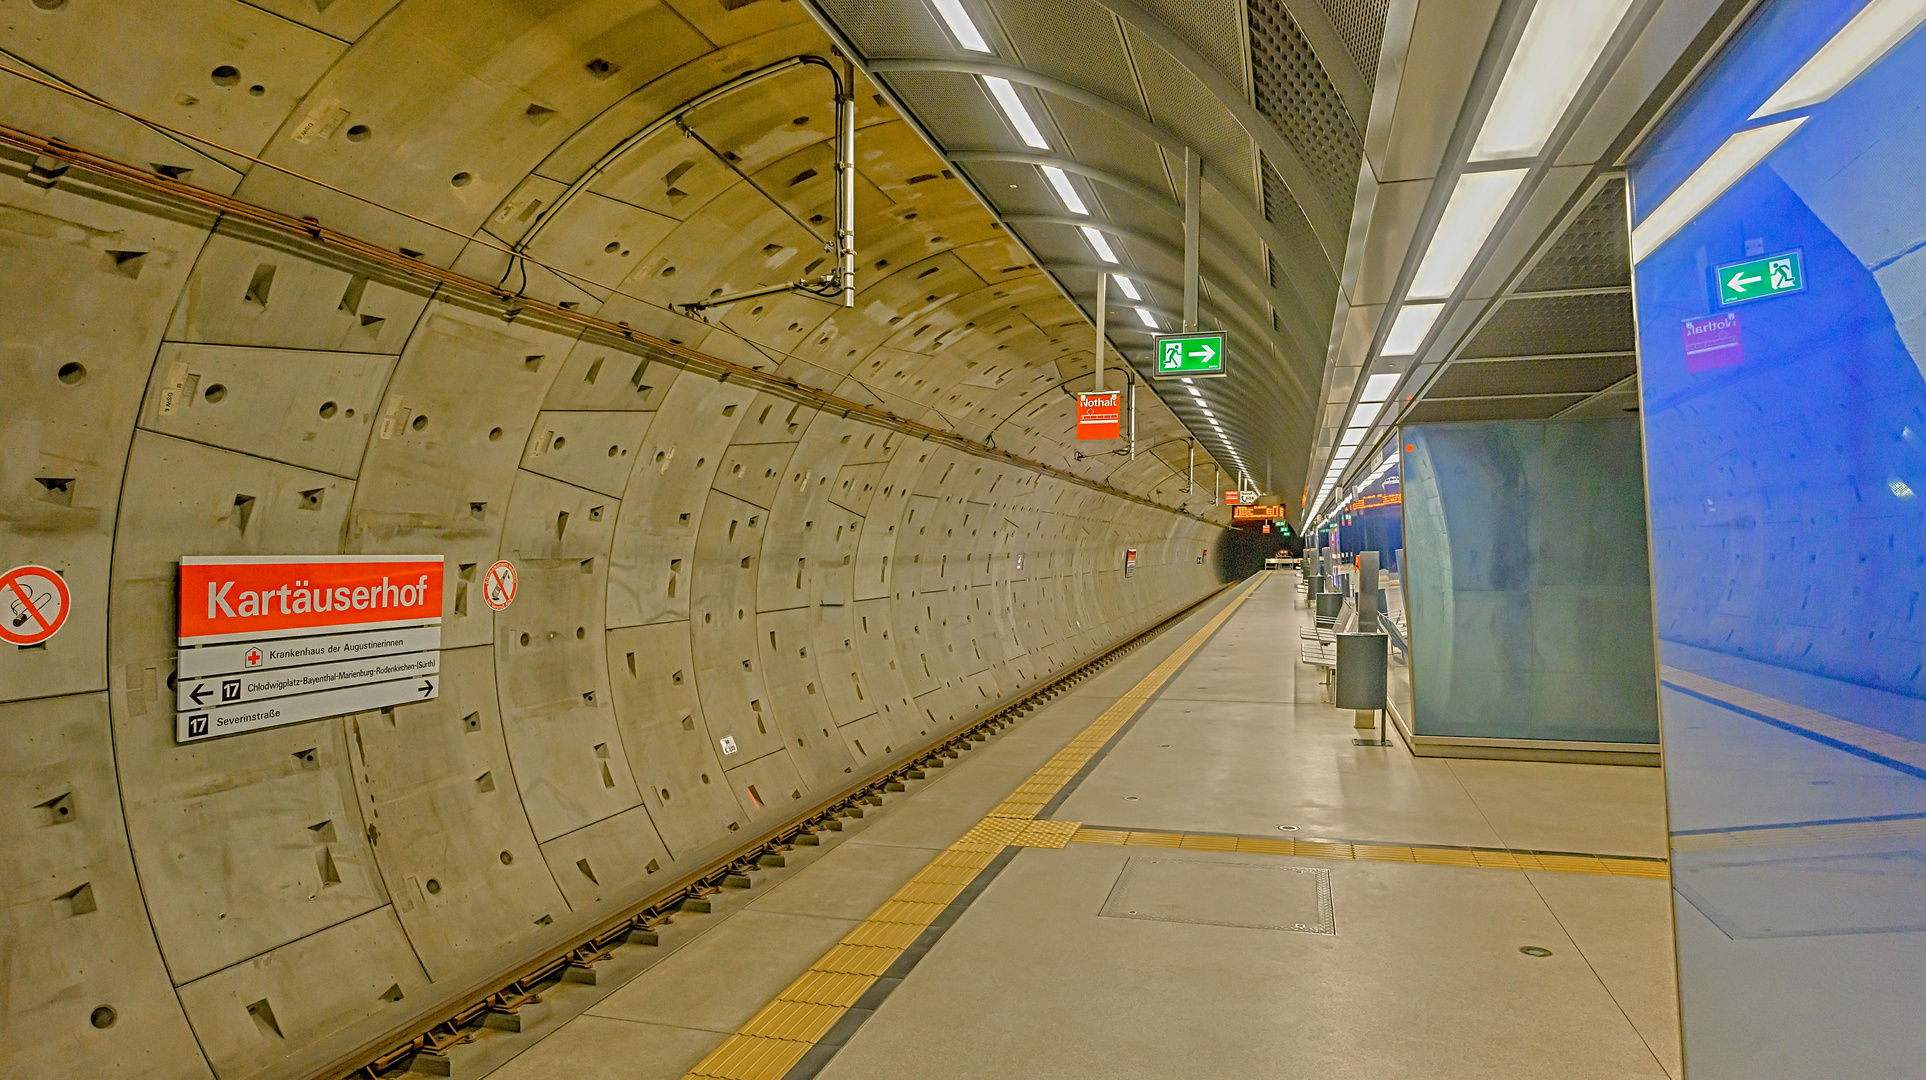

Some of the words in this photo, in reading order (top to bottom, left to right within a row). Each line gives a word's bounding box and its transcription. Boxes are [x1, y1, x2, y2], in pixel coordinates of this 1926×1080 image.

[207, 575, 428, 619] Kartäuserhof
[269, 647, 325, 660] Krankenhaus
[327, 645, 341, 654] der
[343, 639, 404, 652] Augustinerinnen
[223, 682, 240, 699] 17
[247, 659, 436, 693] Chlodwigplatz-Bayenthal-Marienburg-Rodenkirchen-(Sürth)
[190, 717, 207, 734] 17
[216, 709, 281, 727] Severinstraße
